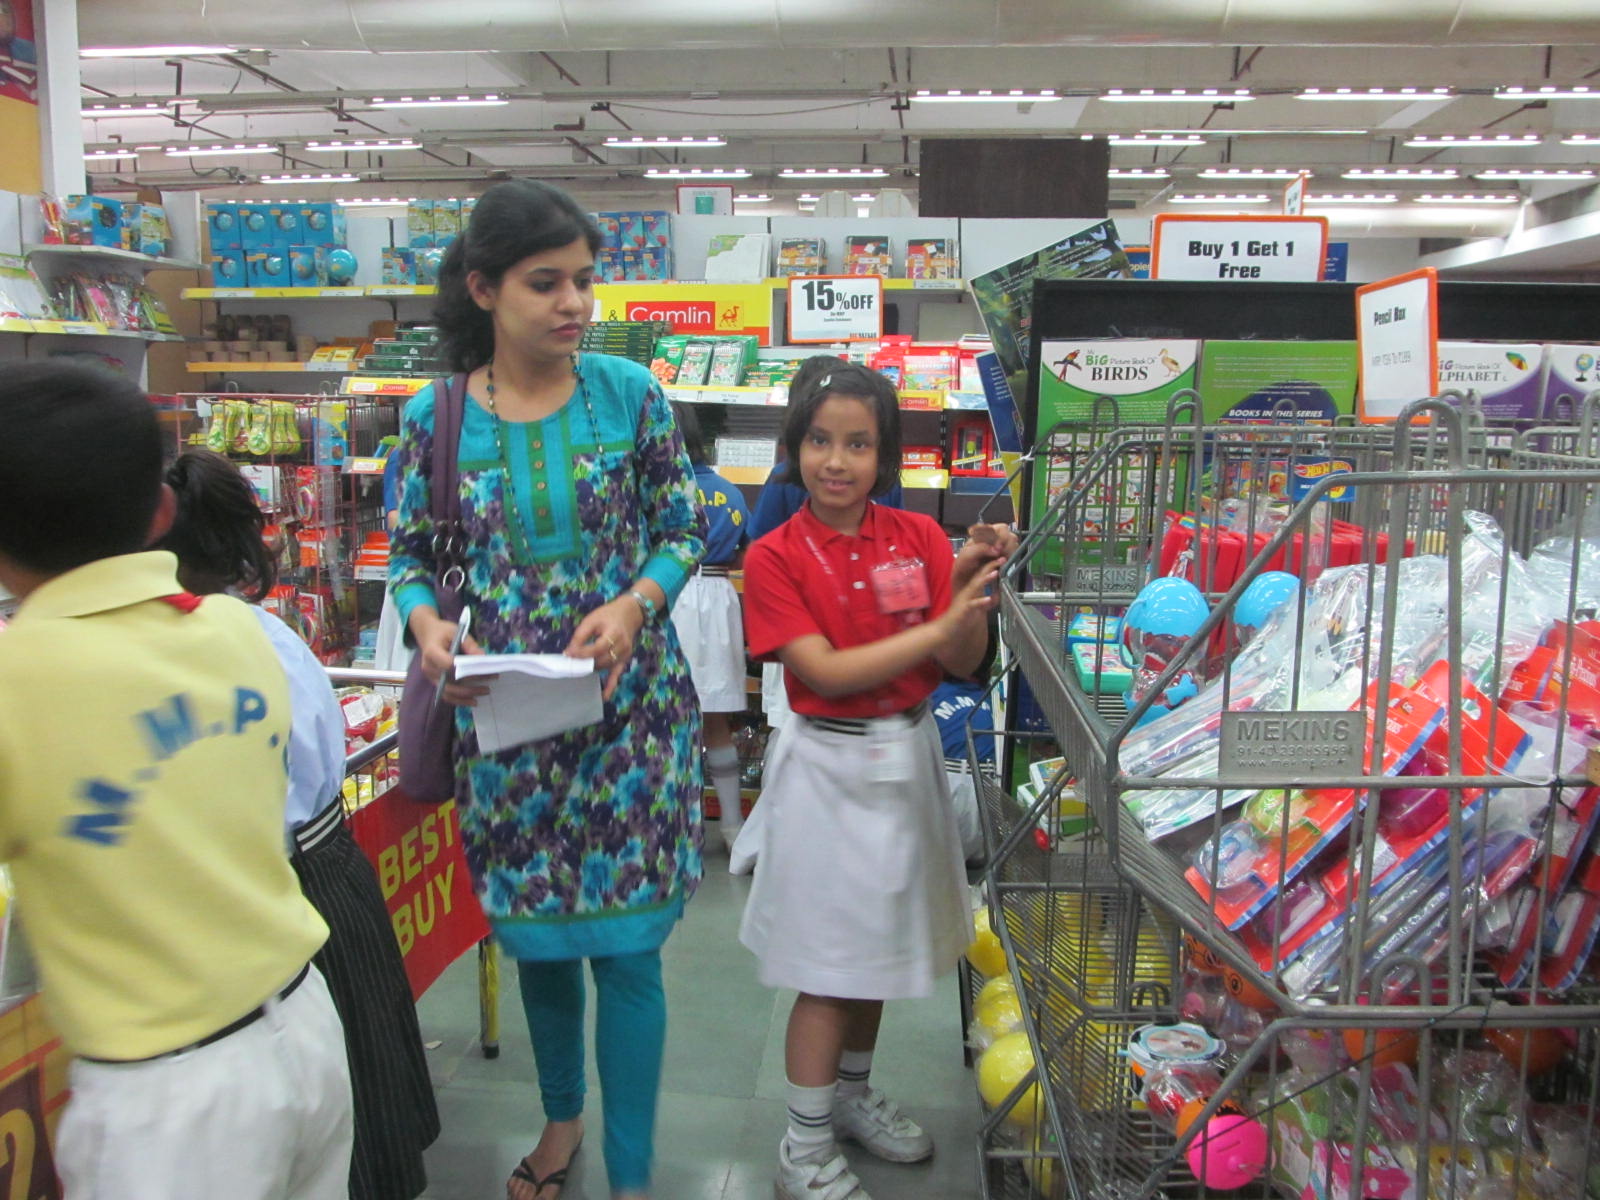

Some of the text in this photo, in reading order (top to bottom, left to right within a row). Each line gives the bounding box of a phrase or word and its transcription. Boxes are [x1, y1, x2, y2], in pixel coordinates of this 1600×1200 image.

[1188, 241, 1294, 258] Buy 1 Get 1
[1219, 263, 1261, 278] Free
[608, 306, 711, 324] & Camlin
[1374, 306, 1406, 326] Pencil Box
[1132, 357, 1146, 365] Book
[1092, 366, 1148, 381] BIRDS
[1438, 371, 1500, 382] LPHABET
[1296, 410, 1323, 418] SERIES
[1077, 567, 1137, 583] MEKINS
[1237, 718, 1350, 741] MEKINS
[378, 797, 456, 901] BEST
[392, 861, 455, 958] BUY
